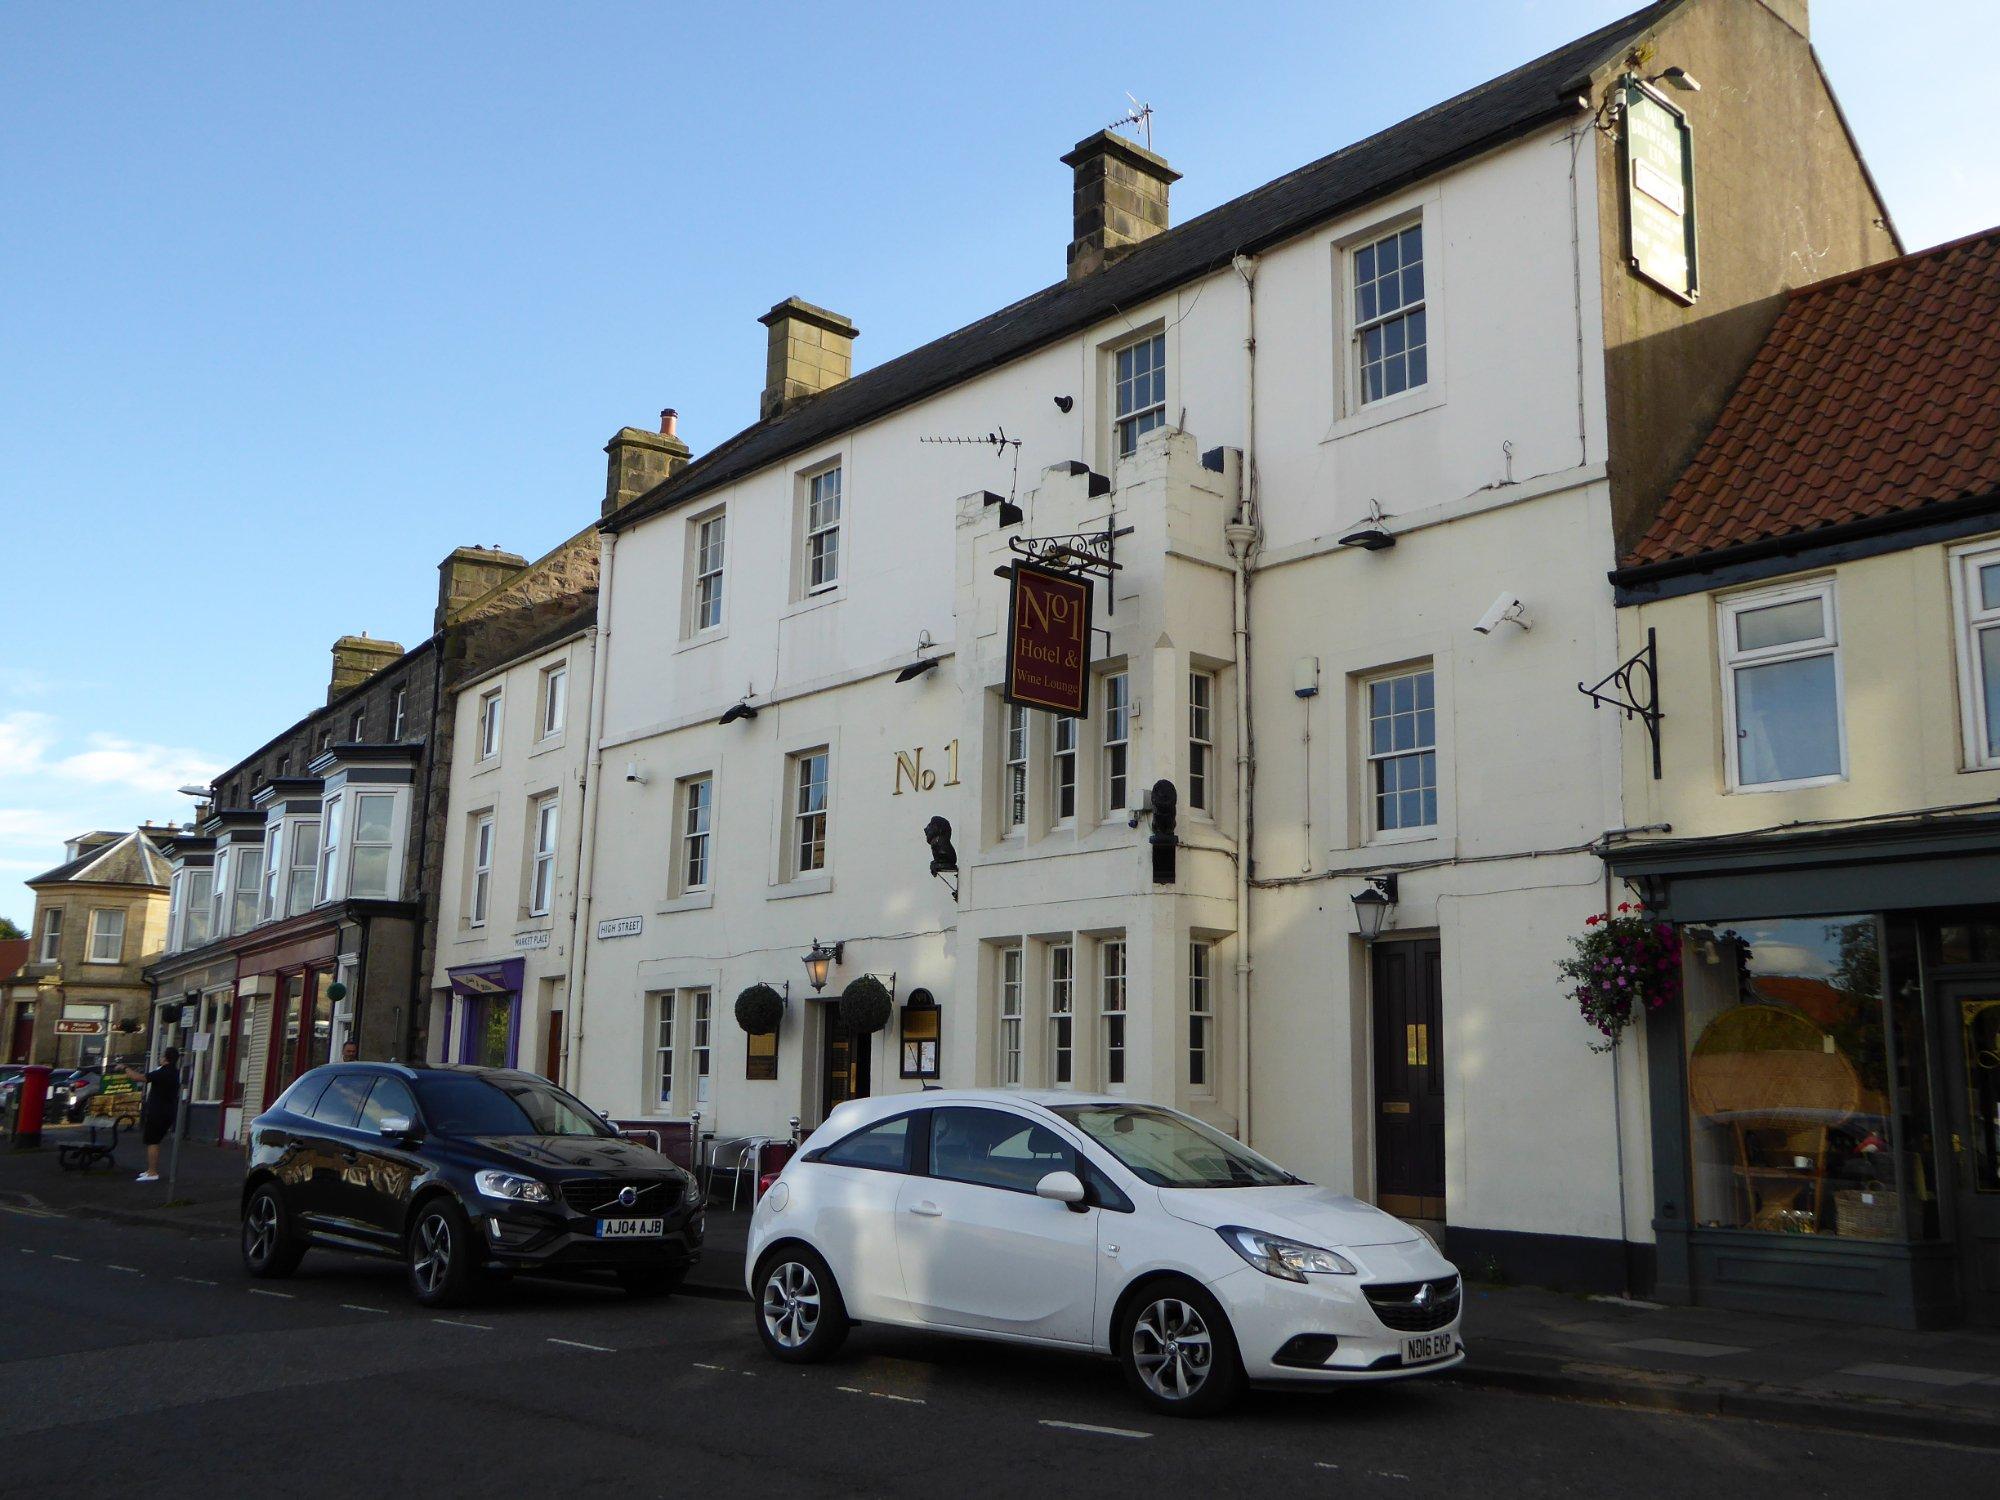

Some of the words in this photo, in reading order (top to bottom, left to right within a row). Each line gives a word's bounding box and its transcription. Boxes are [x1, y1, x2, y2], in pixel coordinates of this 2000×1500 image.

[1020, 637, 1060, 665] Hotel
[1064, 649, 1079, 669] &
[1016, 667, 1042, 686] Wine
[1043, 676, 1080, 696] Lounge
[600, 923, 616, 935] HIGH
[618, 920, 640, 933] STREET
[515, 936, 533, 948] MARKET
[533, 933, 548, 945] PLACE
[606, 1221, 636, 1234] AJ04
[640, 1221, 661, 1234] AJB
[1408, 1338, 1432, 1359] ND16
[1434, 1333, 1451, 1354] EKP
